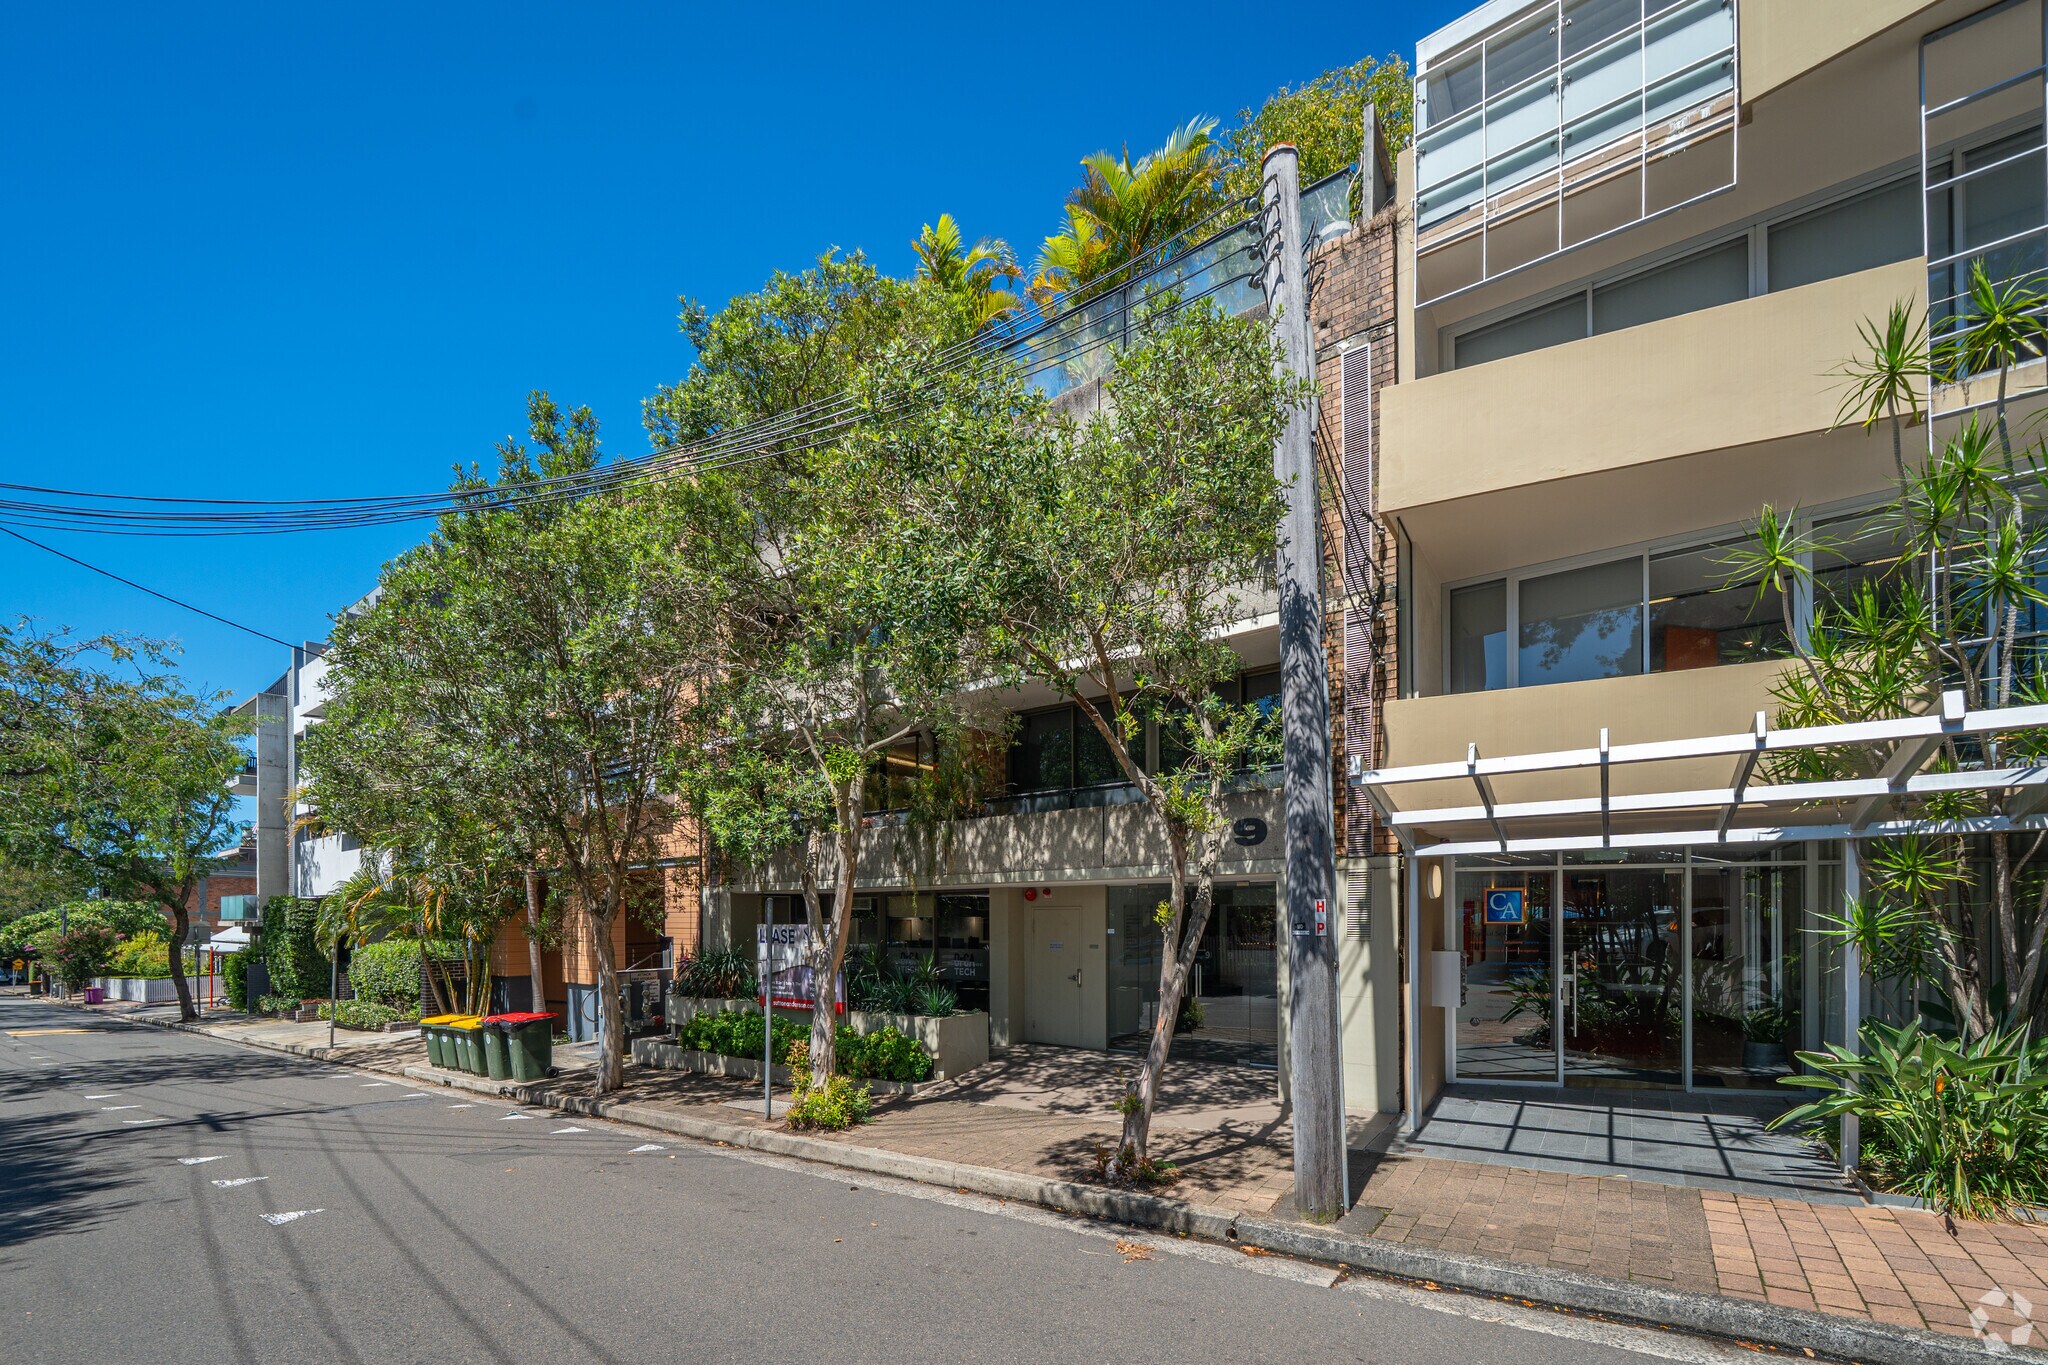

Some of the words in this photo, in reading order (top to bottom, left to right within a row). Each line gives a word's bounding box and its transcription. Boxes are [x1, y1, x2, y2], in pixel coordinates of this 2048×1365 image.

[1233, 818, 1268, 846] 9
[1316, 900, 1325, 913] H
[1490, 893, 1519, 919] CA
[1316, 922, 1325, 934] P
[759, 928, 795, 945] LASE
[954, 967, 976, 977] TECH
